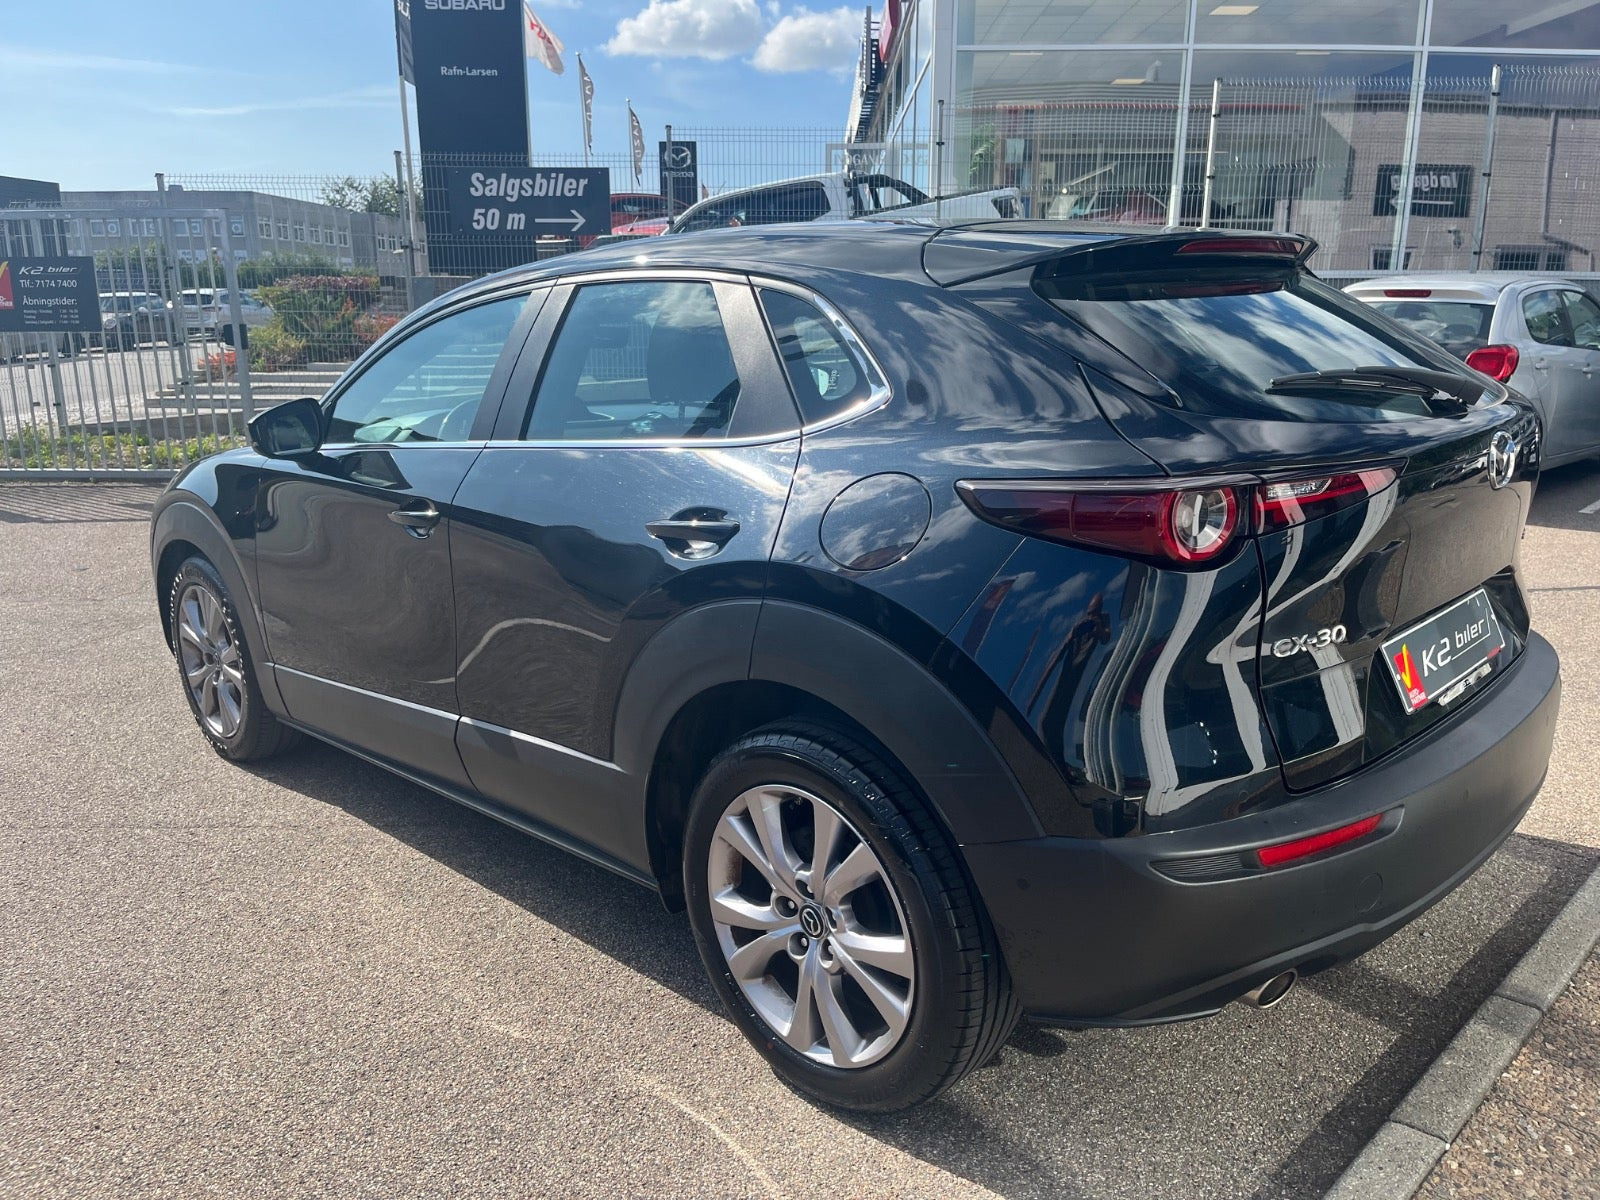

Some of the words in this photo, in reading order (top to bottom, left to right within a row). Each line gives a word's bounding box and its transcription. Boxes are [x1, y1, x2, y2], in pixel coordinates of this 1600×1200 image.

[424, 0, 506, 11] SUBARU
[440, 66, 498, 77] Rafn-Larsen
[470, 172, 589, 202] Salgsbiler
[472, 208, 501, 230] 50
[506, 212, 526, 230] m
[18, 266, 44, 275] K2
[47, 265, 78, 273] biler
[35, 279, 56, 288] 7174
[56, 279, 78, 288] 7400
[22, 295, 78, 308] Åbningstider:
[1272, 624, 1347, 658] CX-30
[1421, 637, 1453, 678] K2
[1454, 618, 1485, 649] biler
